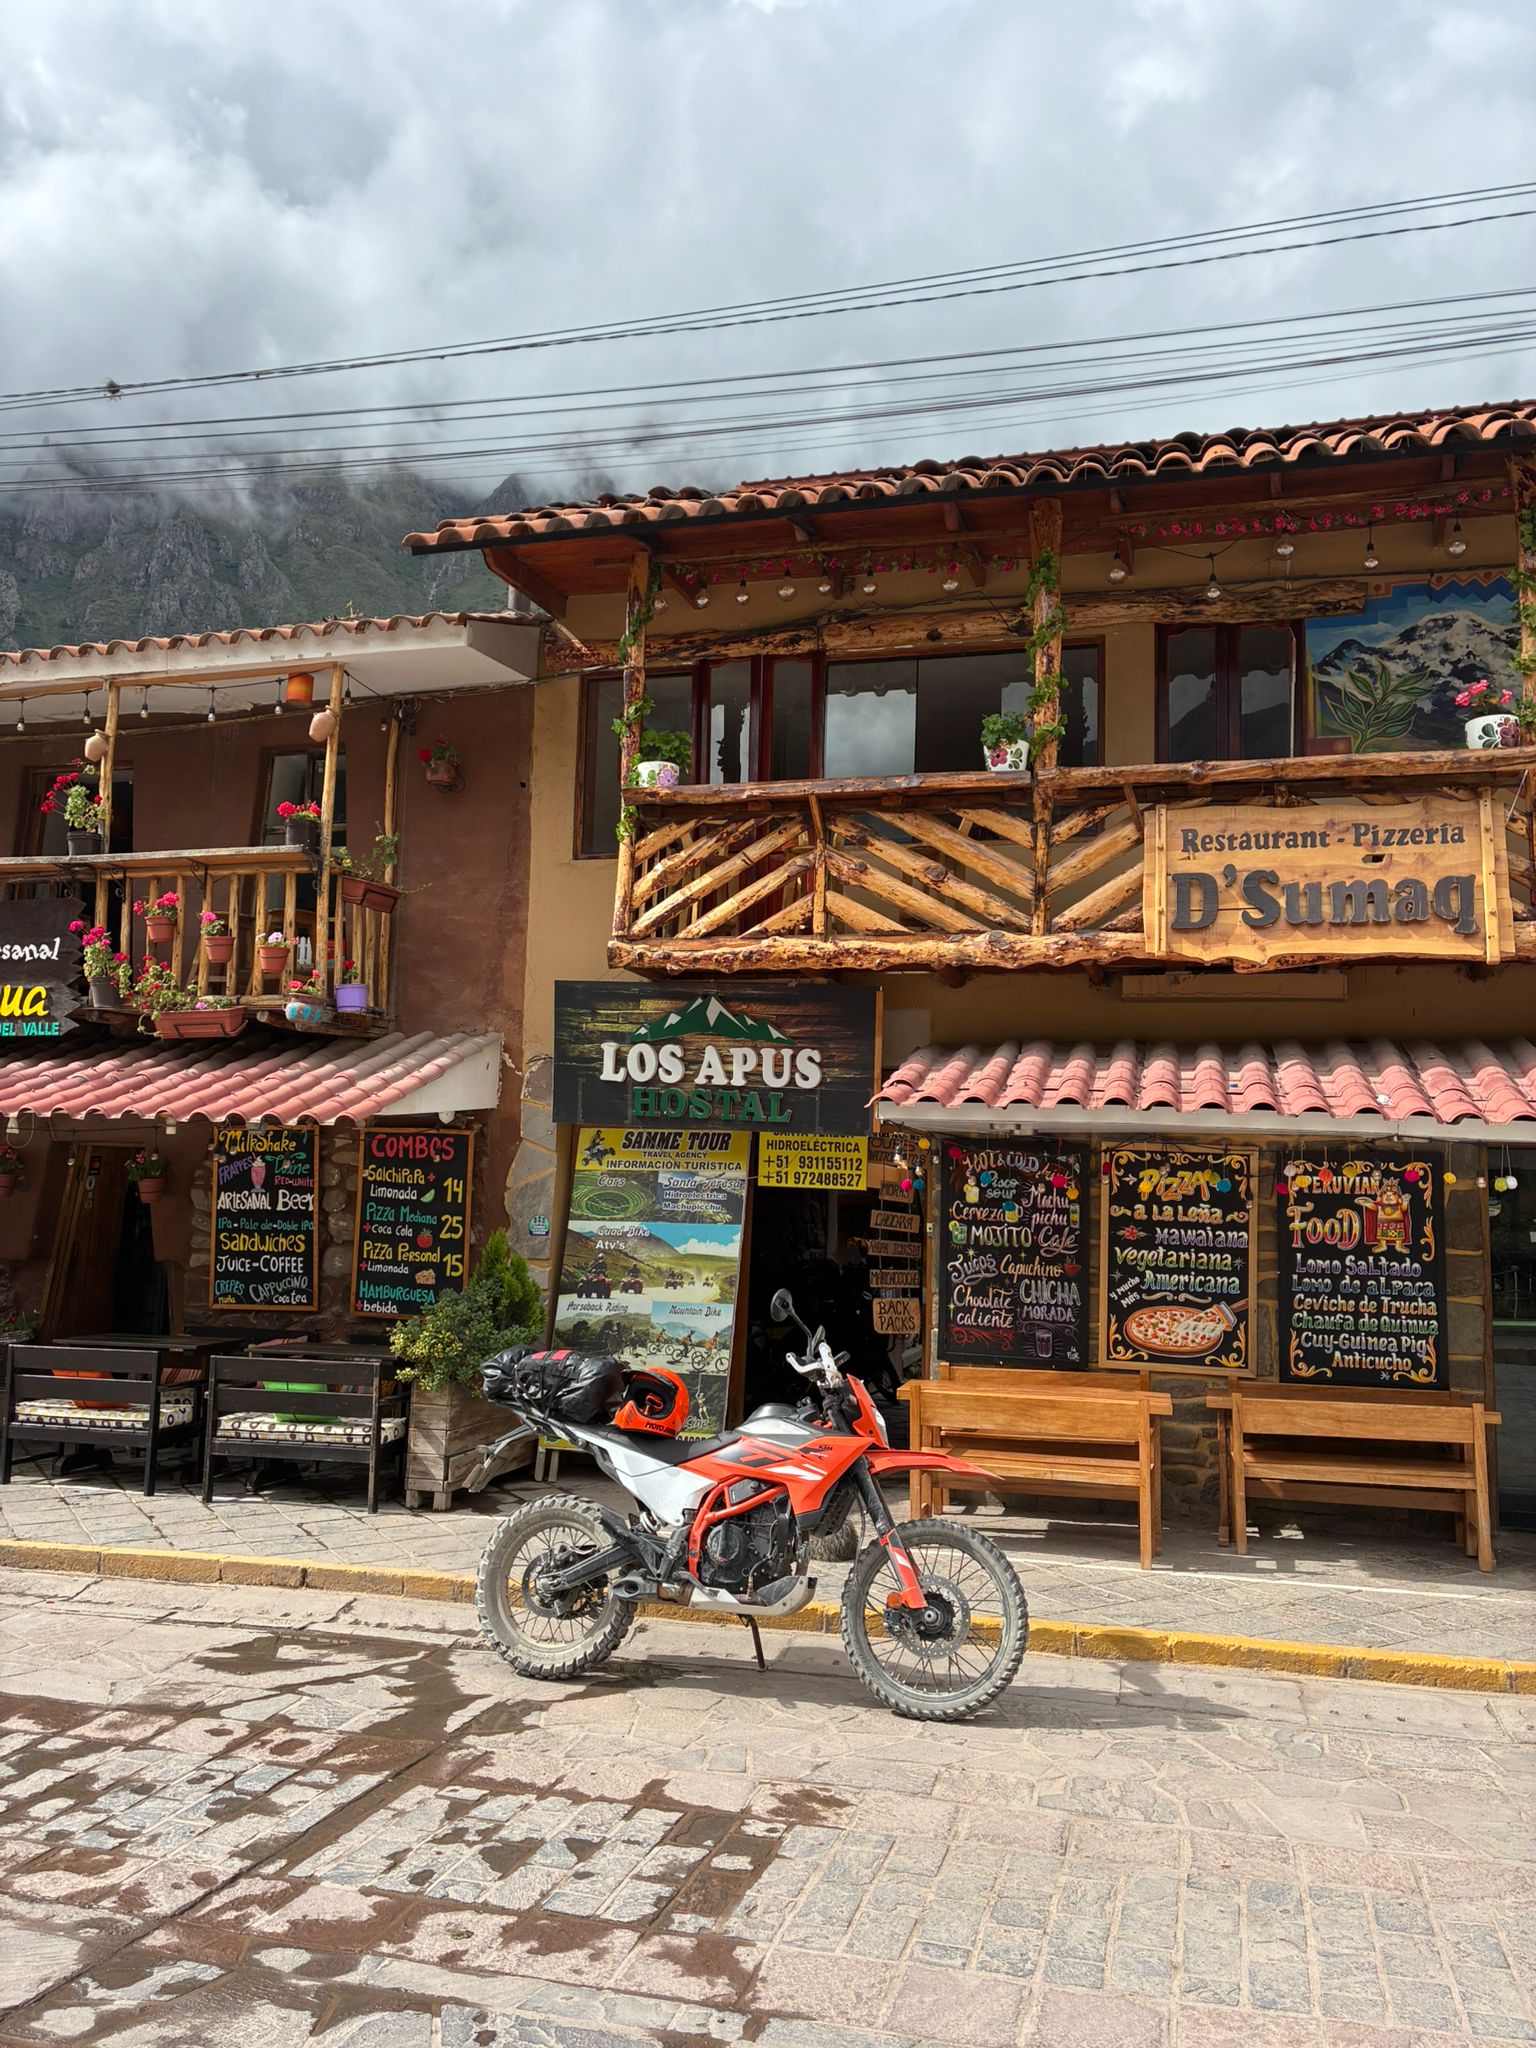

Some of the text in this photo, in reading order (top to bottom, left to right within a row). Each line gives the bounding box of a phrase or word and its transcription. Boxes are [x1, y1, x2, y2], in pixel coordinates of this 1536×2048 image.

[1180, 827, 1330, 854] Restaurant
[1352, 822, 1466, 848] Pizzería
[0, 936, 61, 961] sanal
[0, 1021, 60, 1037] EL VALLE
[600, 1042, 823, 1090] LOS APUS
[632, 1086, 793, 1123] HOSTAL
[371, 1134, 455, 1161] COMBOS
[688, 1132, 732, 1151] TOUR
[766, 1139, 861, 1153] HIDROELÉCTRICA
[763, 1155, 789, 1168] +51
[799, 1156, 863, 1171] 931155112
[598, 1174, 626, 1187] Cars
[663, 1177, 698, 1188] Santa
[763, 1171, 862, 1188] +51 972488527
[276, 1189, 315, 1212] Beer
[370, 1183, 418, 1200] Limonada
[443, 1177, 463, 1204] 14
[664, 1191, 727, 1200] Hidroelectrica
[986, 1189, 1017, 1199] sour
[662, 1203, 721, 1211] Machupicchu
[1133, 1204, 1148, 1220] a
[439, 1216, 463, 1239] 25
[1031, 1209, 1068, 1233] pichu
[626, 1226, 651, 1238] Bike
[1038, 1226, 1080, 1256] Café
[1155, 1226, 1248, 1248] Hawaiana
[220, 1232, 306, 1253] Sandwiches
[595, 1239, 626, 1250] Atv's
[442, 1253, 464, 1277] 15
[1000, 1254, 1063, 1283] Capuchino
[1114, 1246, 1232, 1272] Vegetariana
[359, 1279, 436, 1303] HAMBURGUESA
[1140, 1270, 1240, 1294] Americana
[1339, 1275, 1361, 1294] de
[566, 1301, 629, 1313] Horseback Riding
[953, 1285, 1014, 1309] Chocolate
[1358, 1295, 1378, 1312] de
[1381, 1296, 1438, 1316] Trucha
[668, 1305, 722, 1317] Mountain Bike
[878, 1301, 911, 1315] BACK
[956, 1308, 1014, 1328] caliente
[1022, 1305, 1075, 1322] MORADA
[879, 1315, 916, 1331] PACKS
[1292, 1311, 1439, 1335] Chaufa de Quinua
[1400, 1336, 1427, 1357] Pig
[1331, 1351, 1412, 1371] Anticucho
